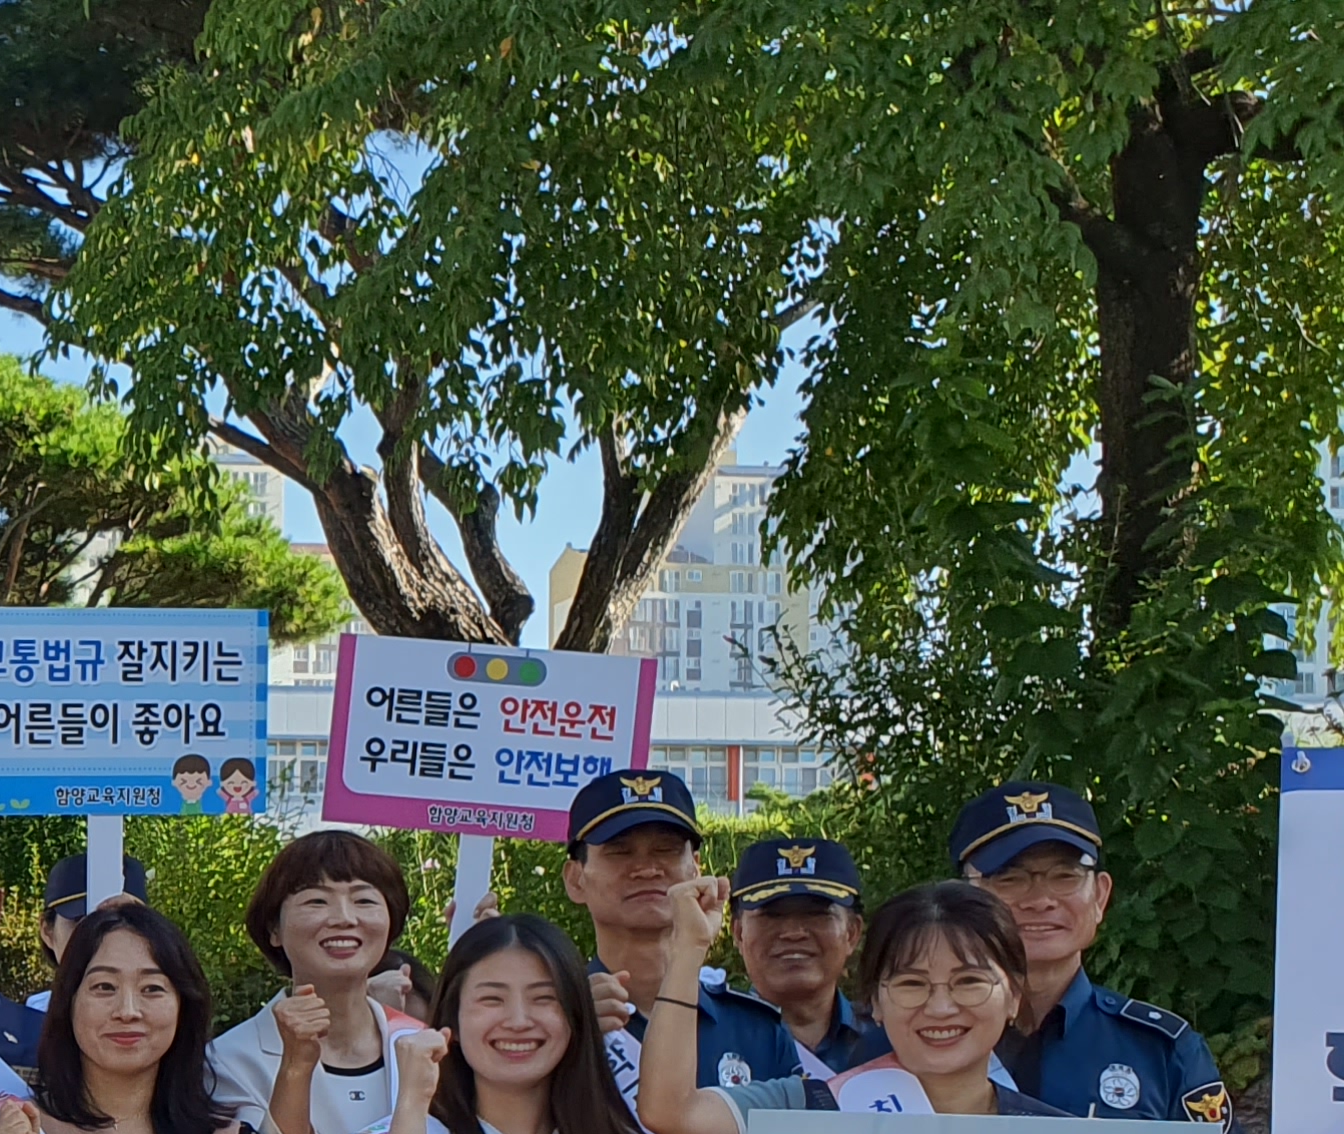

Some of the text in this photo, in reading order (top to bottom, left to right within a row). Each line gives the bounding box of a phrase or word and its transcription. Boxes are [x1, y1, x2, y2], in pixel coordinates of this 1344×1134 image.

[117, 640, 243, 682] 잘지키는
[132, 703, 227, 746] 좋아요
[366, 686, 617, 741] 어른들은 안전운전
[360, 737, 476, 781] 우리들은
[55, 787, 161, 806] 함양교육지원청
[428, 804, 535, 831] 함양교육지원청
